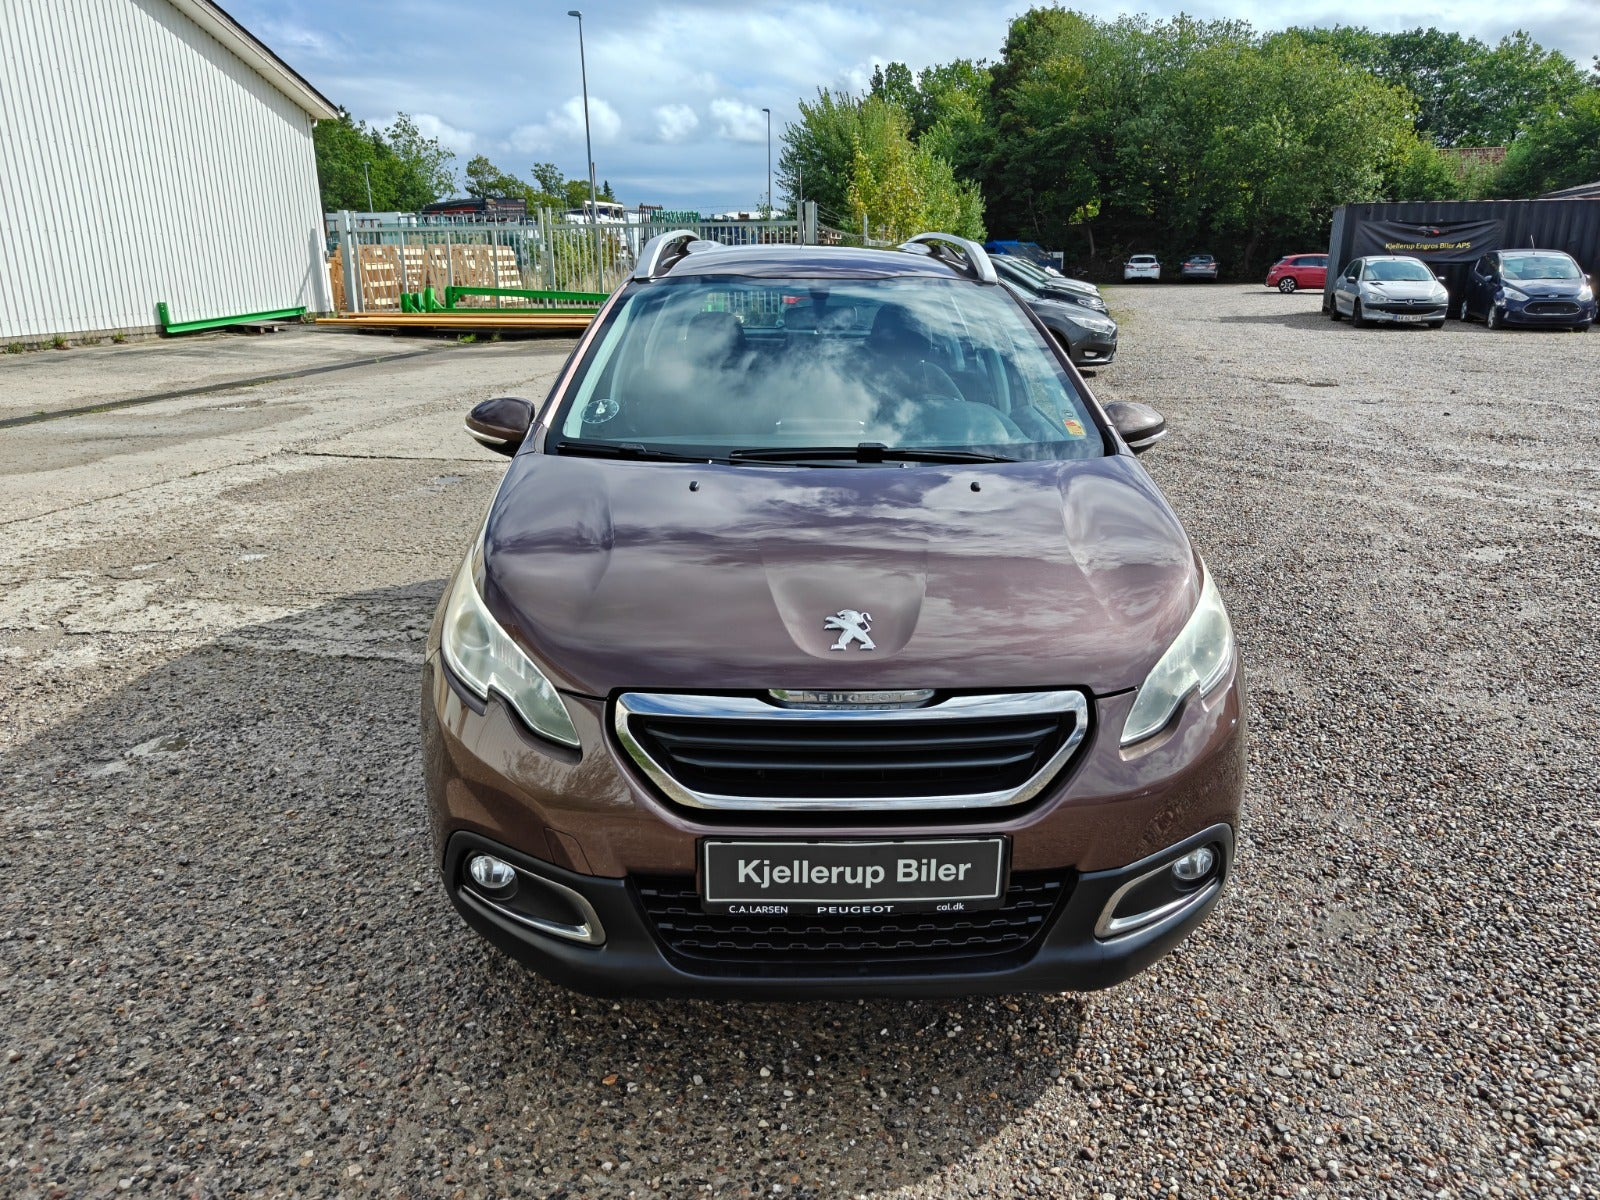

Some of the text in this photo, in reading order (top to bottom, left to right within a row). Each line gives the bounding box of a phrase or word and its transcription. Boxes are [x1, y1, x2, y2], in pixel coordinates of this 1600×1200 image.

[1385, 242, 1415, 250] Kjellerup
[1416, 242, 1439, 250] Engros
[738, 858, 972, 889] Kjellerup Biler
[817, 905, 895, 914] PEUGEOT
[936, 902, 965, 911] cal.dk
